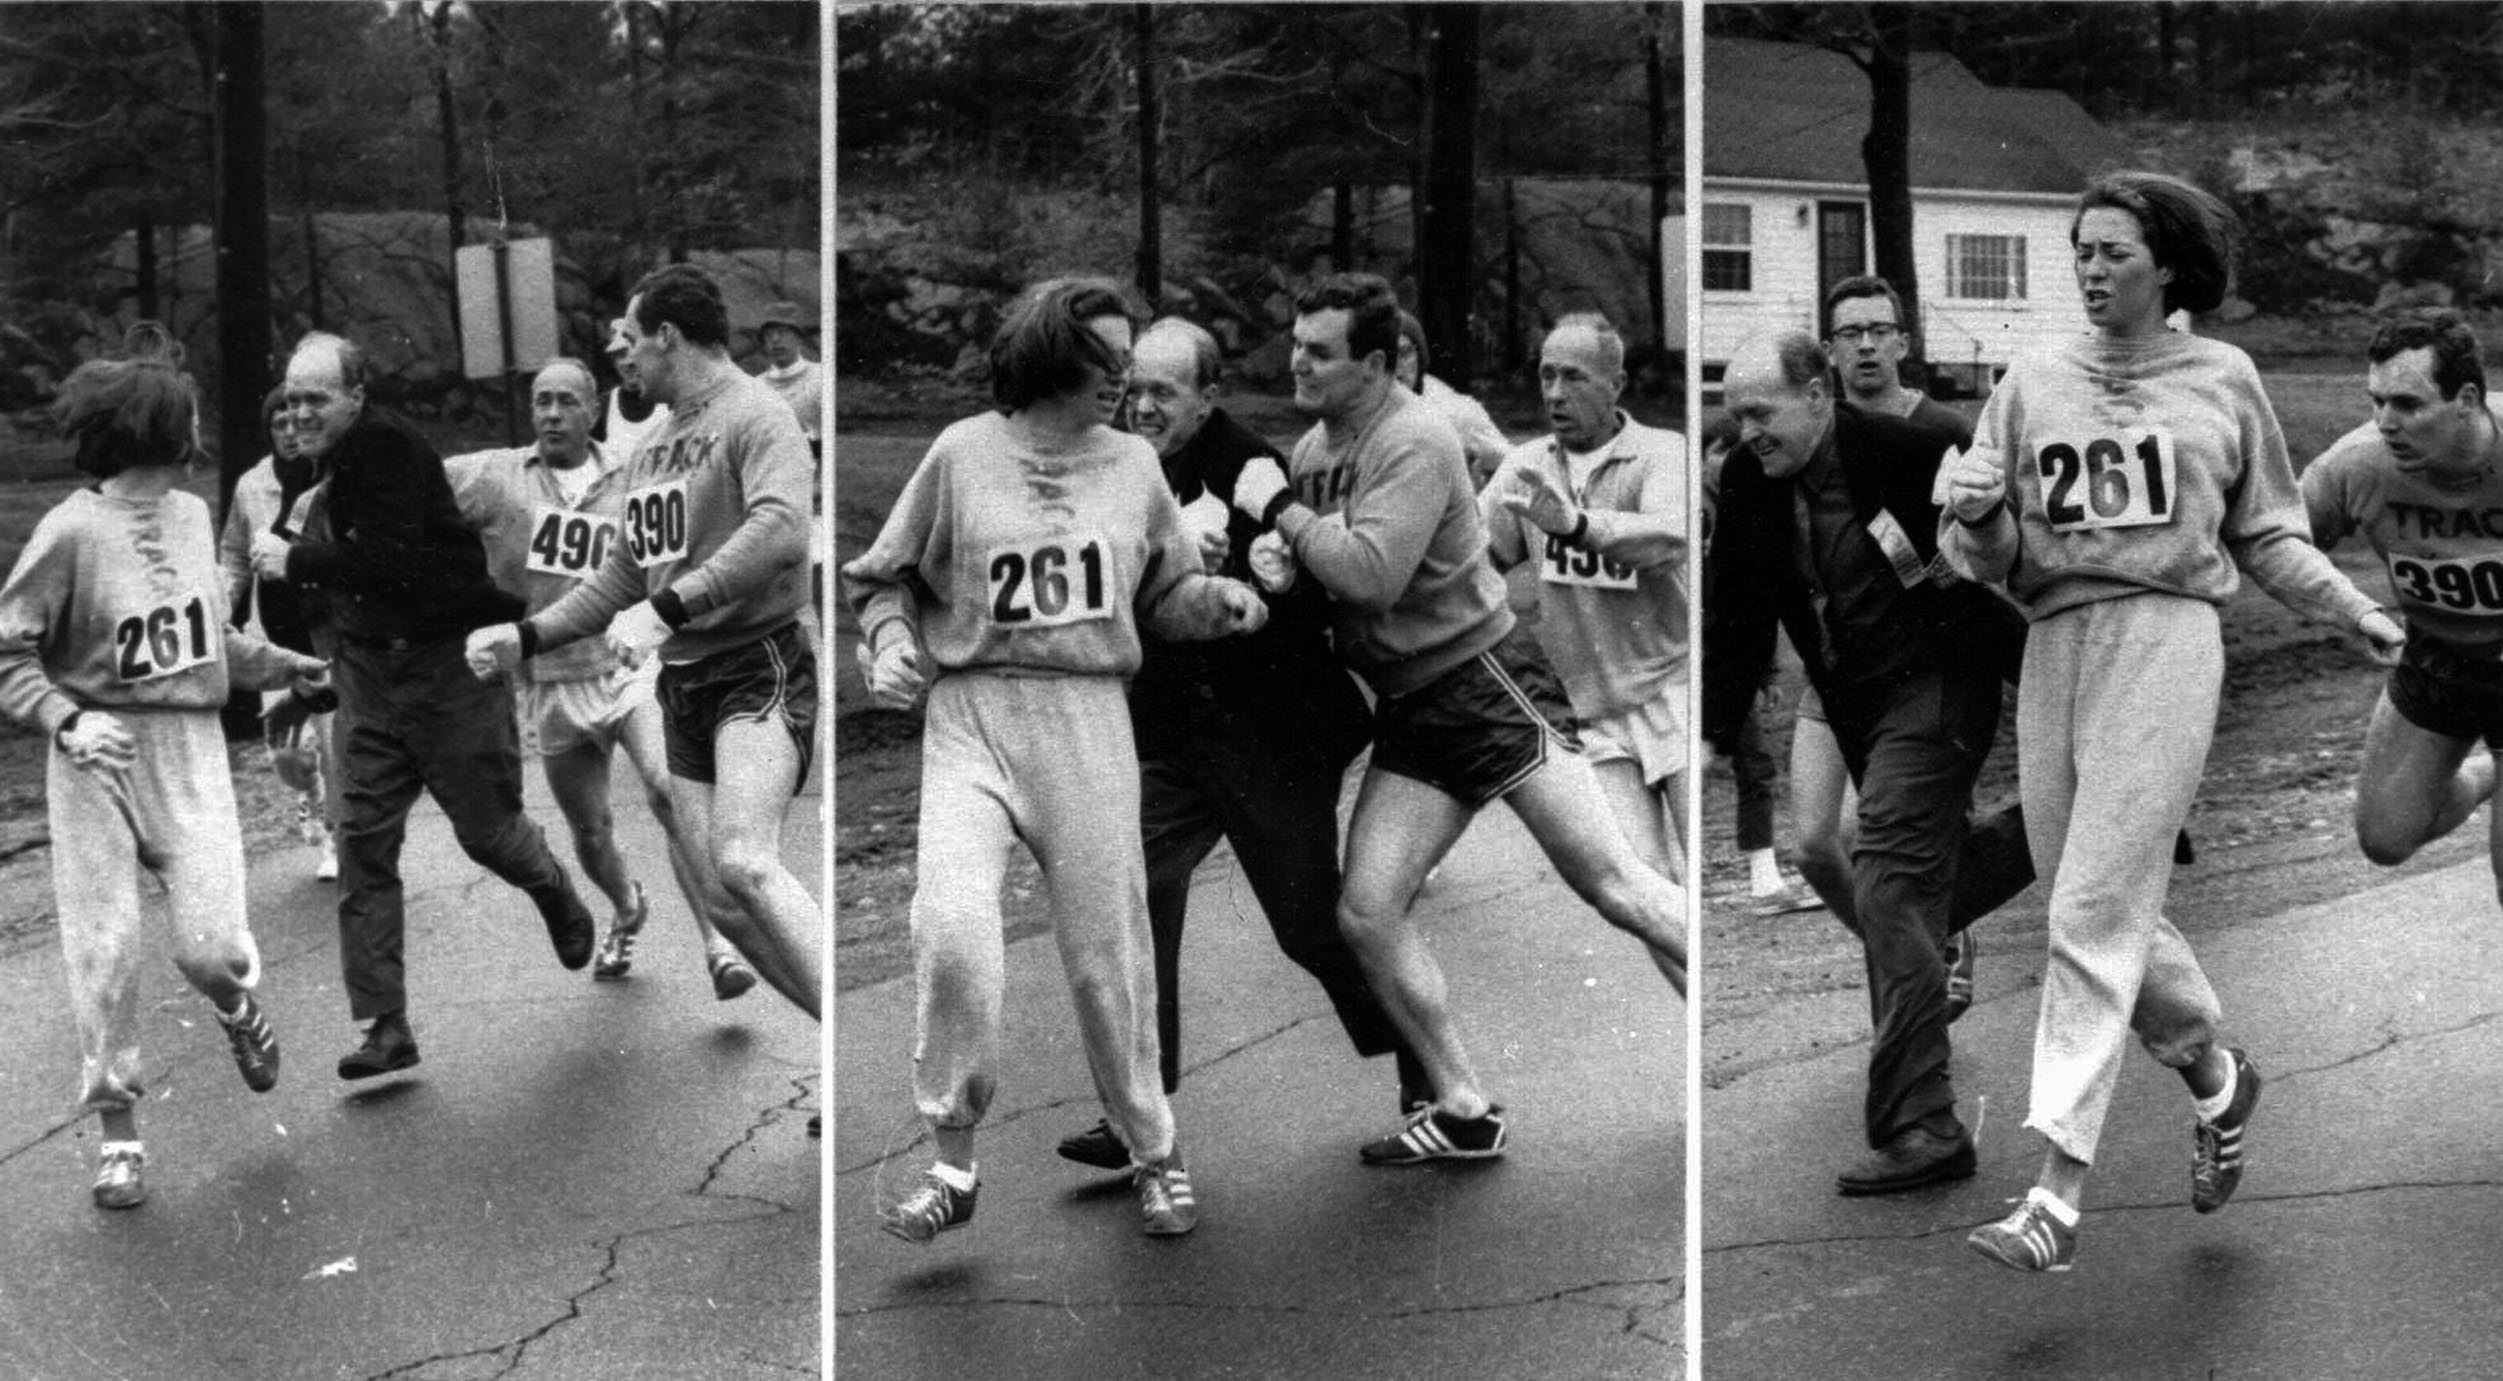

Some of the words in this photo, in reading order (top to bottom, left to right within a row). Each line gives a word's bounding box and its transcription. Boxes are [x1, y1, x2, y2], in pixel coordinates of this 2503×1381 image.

[2039, 434, 2167, 525] 261
[627, 488, 686, 562] 390
[990, 540, 1103, 623] 261
[2394, 561, 2503, 610] 390
[116, 597, 207, 680] 261
